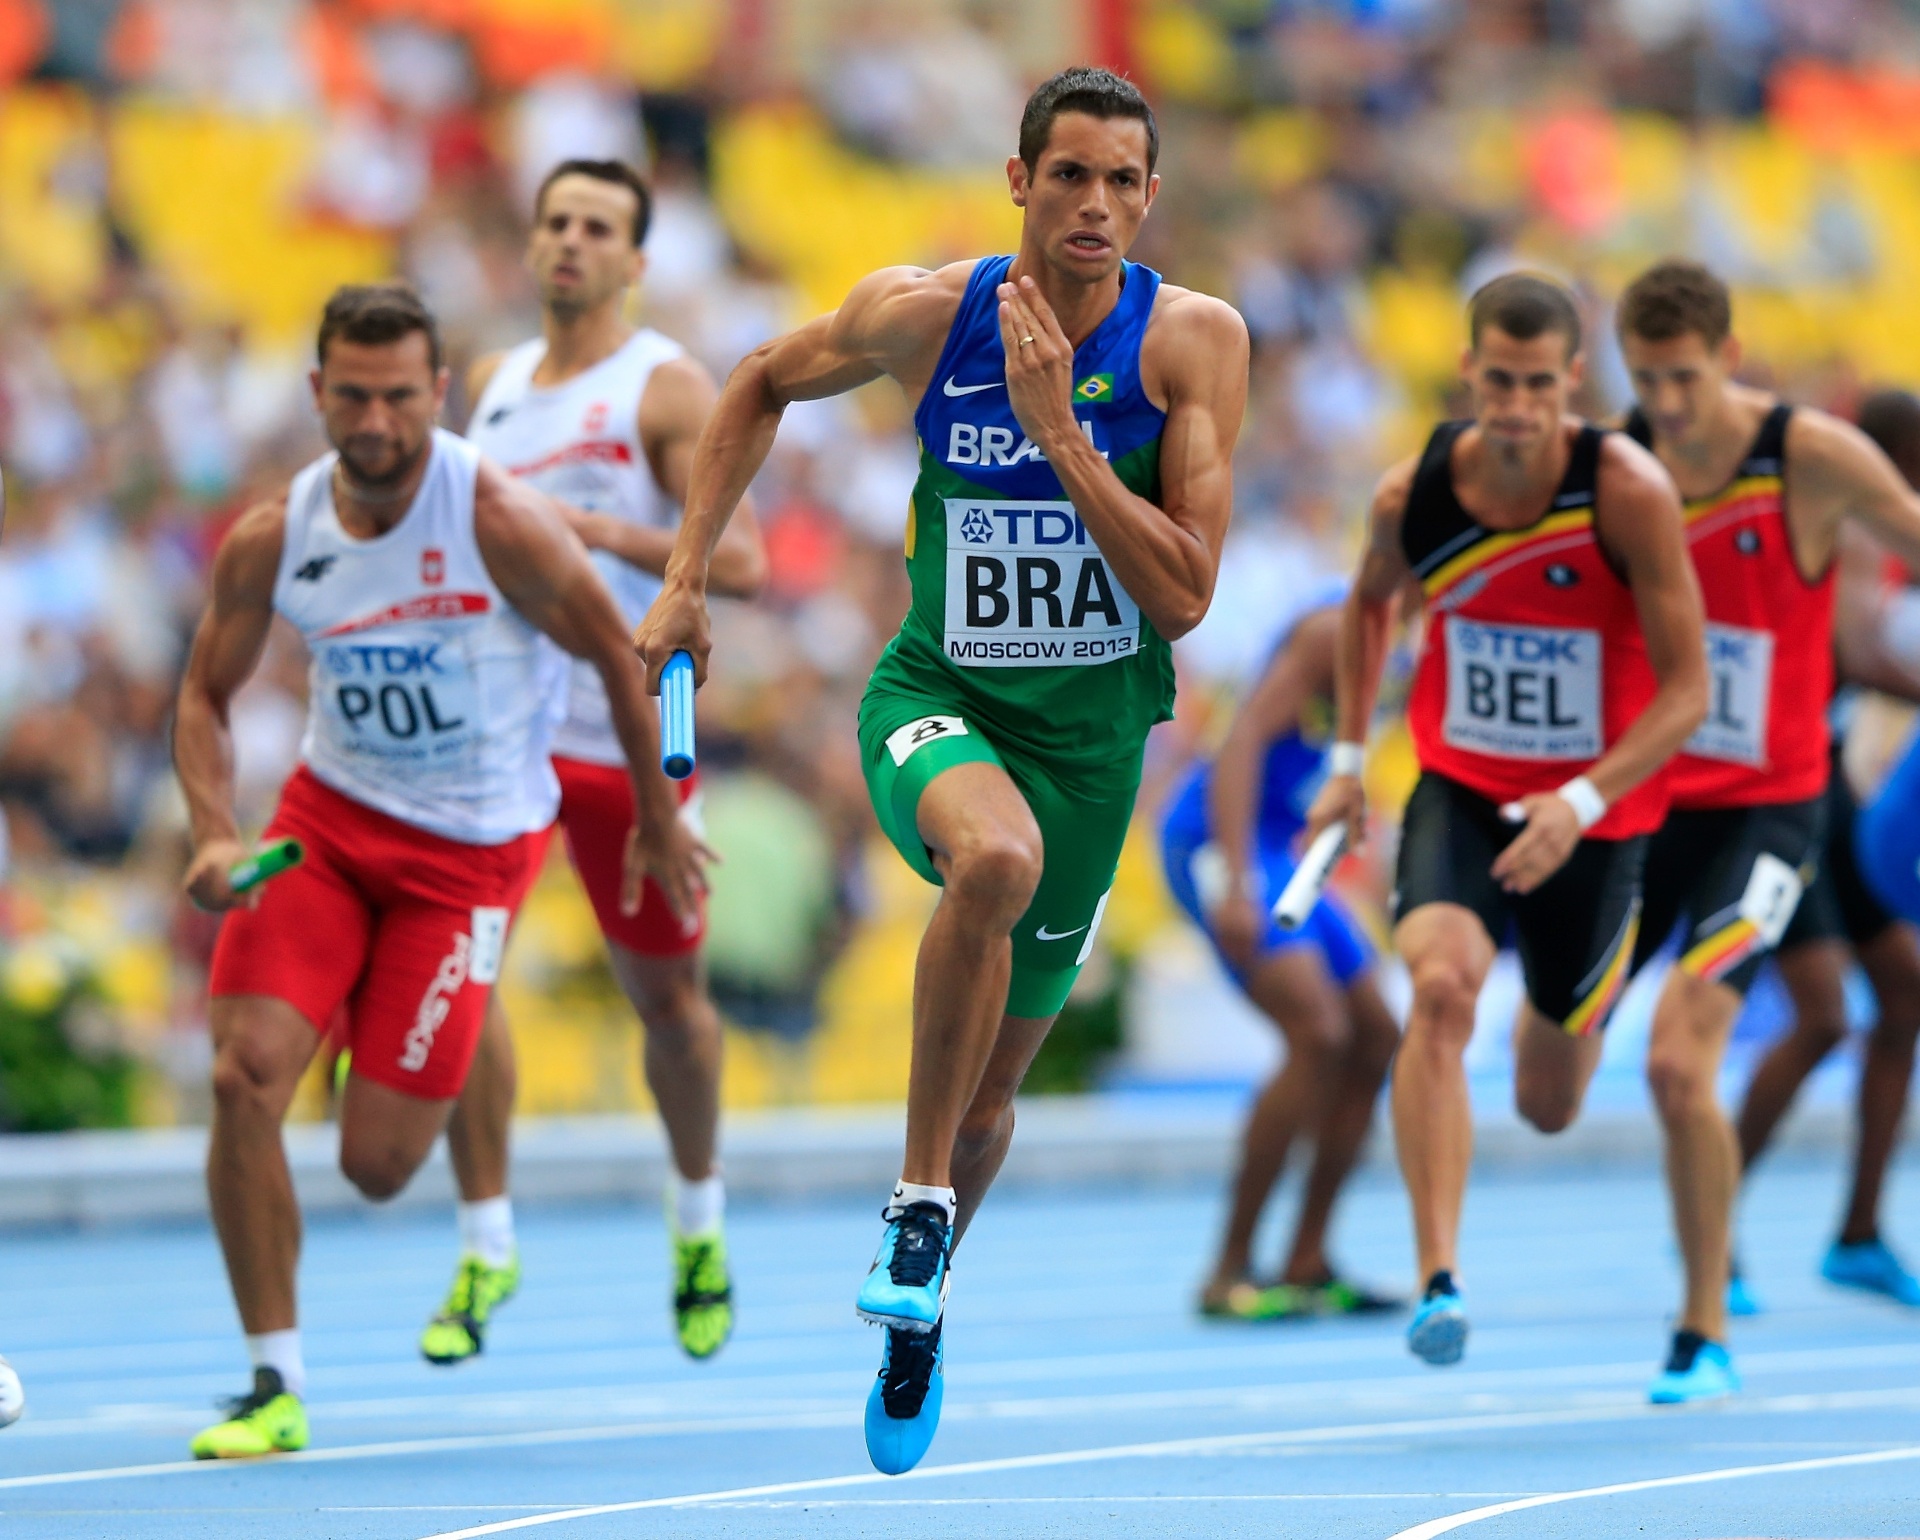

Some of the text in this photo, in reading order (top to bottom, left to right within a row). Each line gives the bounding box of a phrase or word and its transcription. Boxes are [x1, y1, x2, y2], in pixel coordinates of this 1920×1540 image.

[966, 556, 1122, 628] BRA
[350, 644, 444, 675] TDK
[951, 637, 1131, 658] MOSCOW 2013
[1484, 627, 1579, 664] TDK
[337, 682, 465, 739] POL
[1467, 662, 1579, 727] BEL
